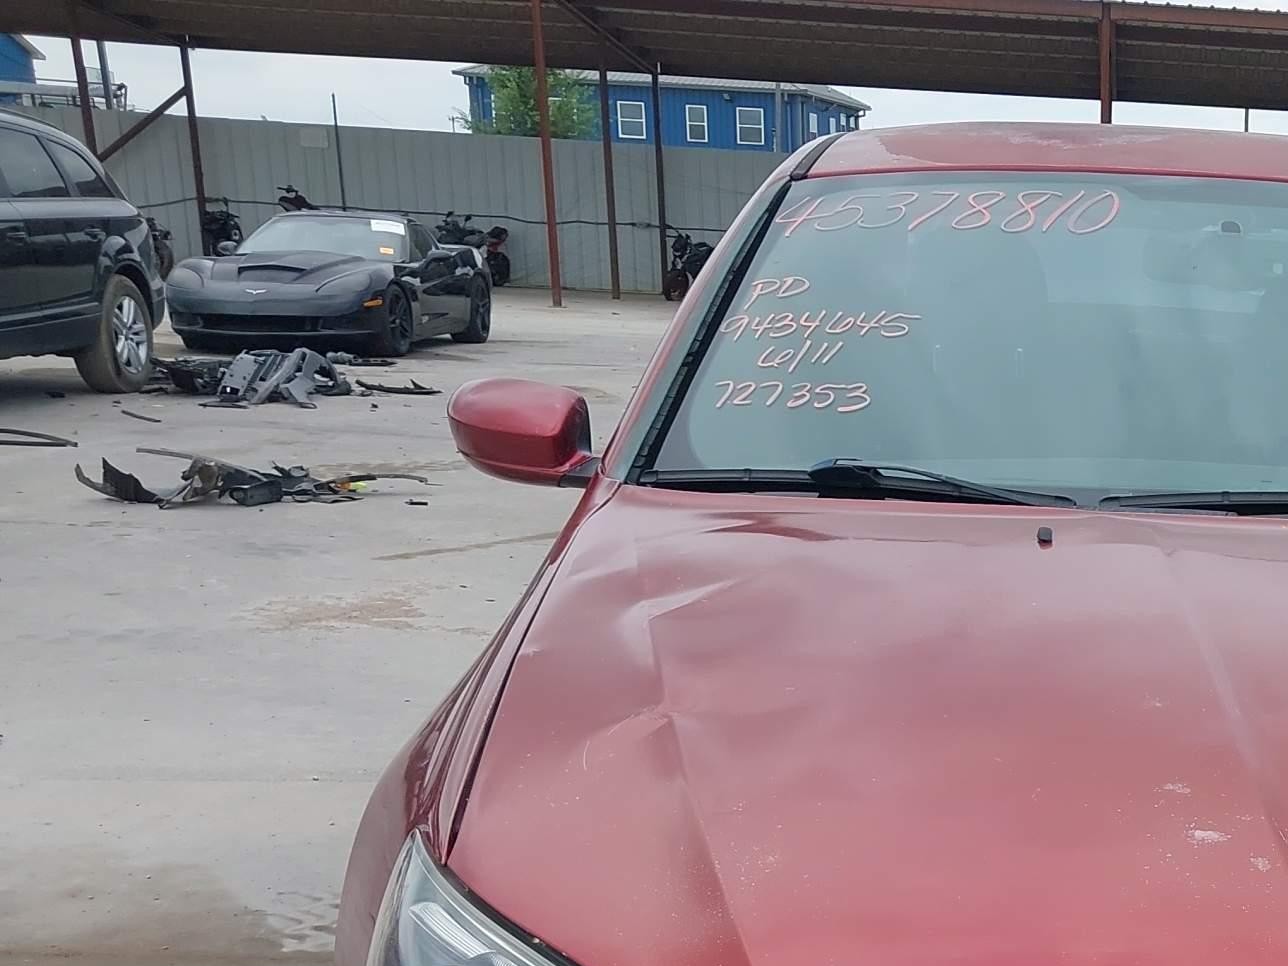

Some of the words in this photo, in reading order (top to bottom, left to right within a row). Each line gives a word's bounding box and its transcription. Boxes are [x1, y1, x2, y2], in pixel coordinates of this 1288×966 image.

[775, 190, 1121, 237] 45378810
[744, 276, 810, 310] PD
[720, 310, 923, 342] 9434645
[715, 380, 871, 412] 727353
